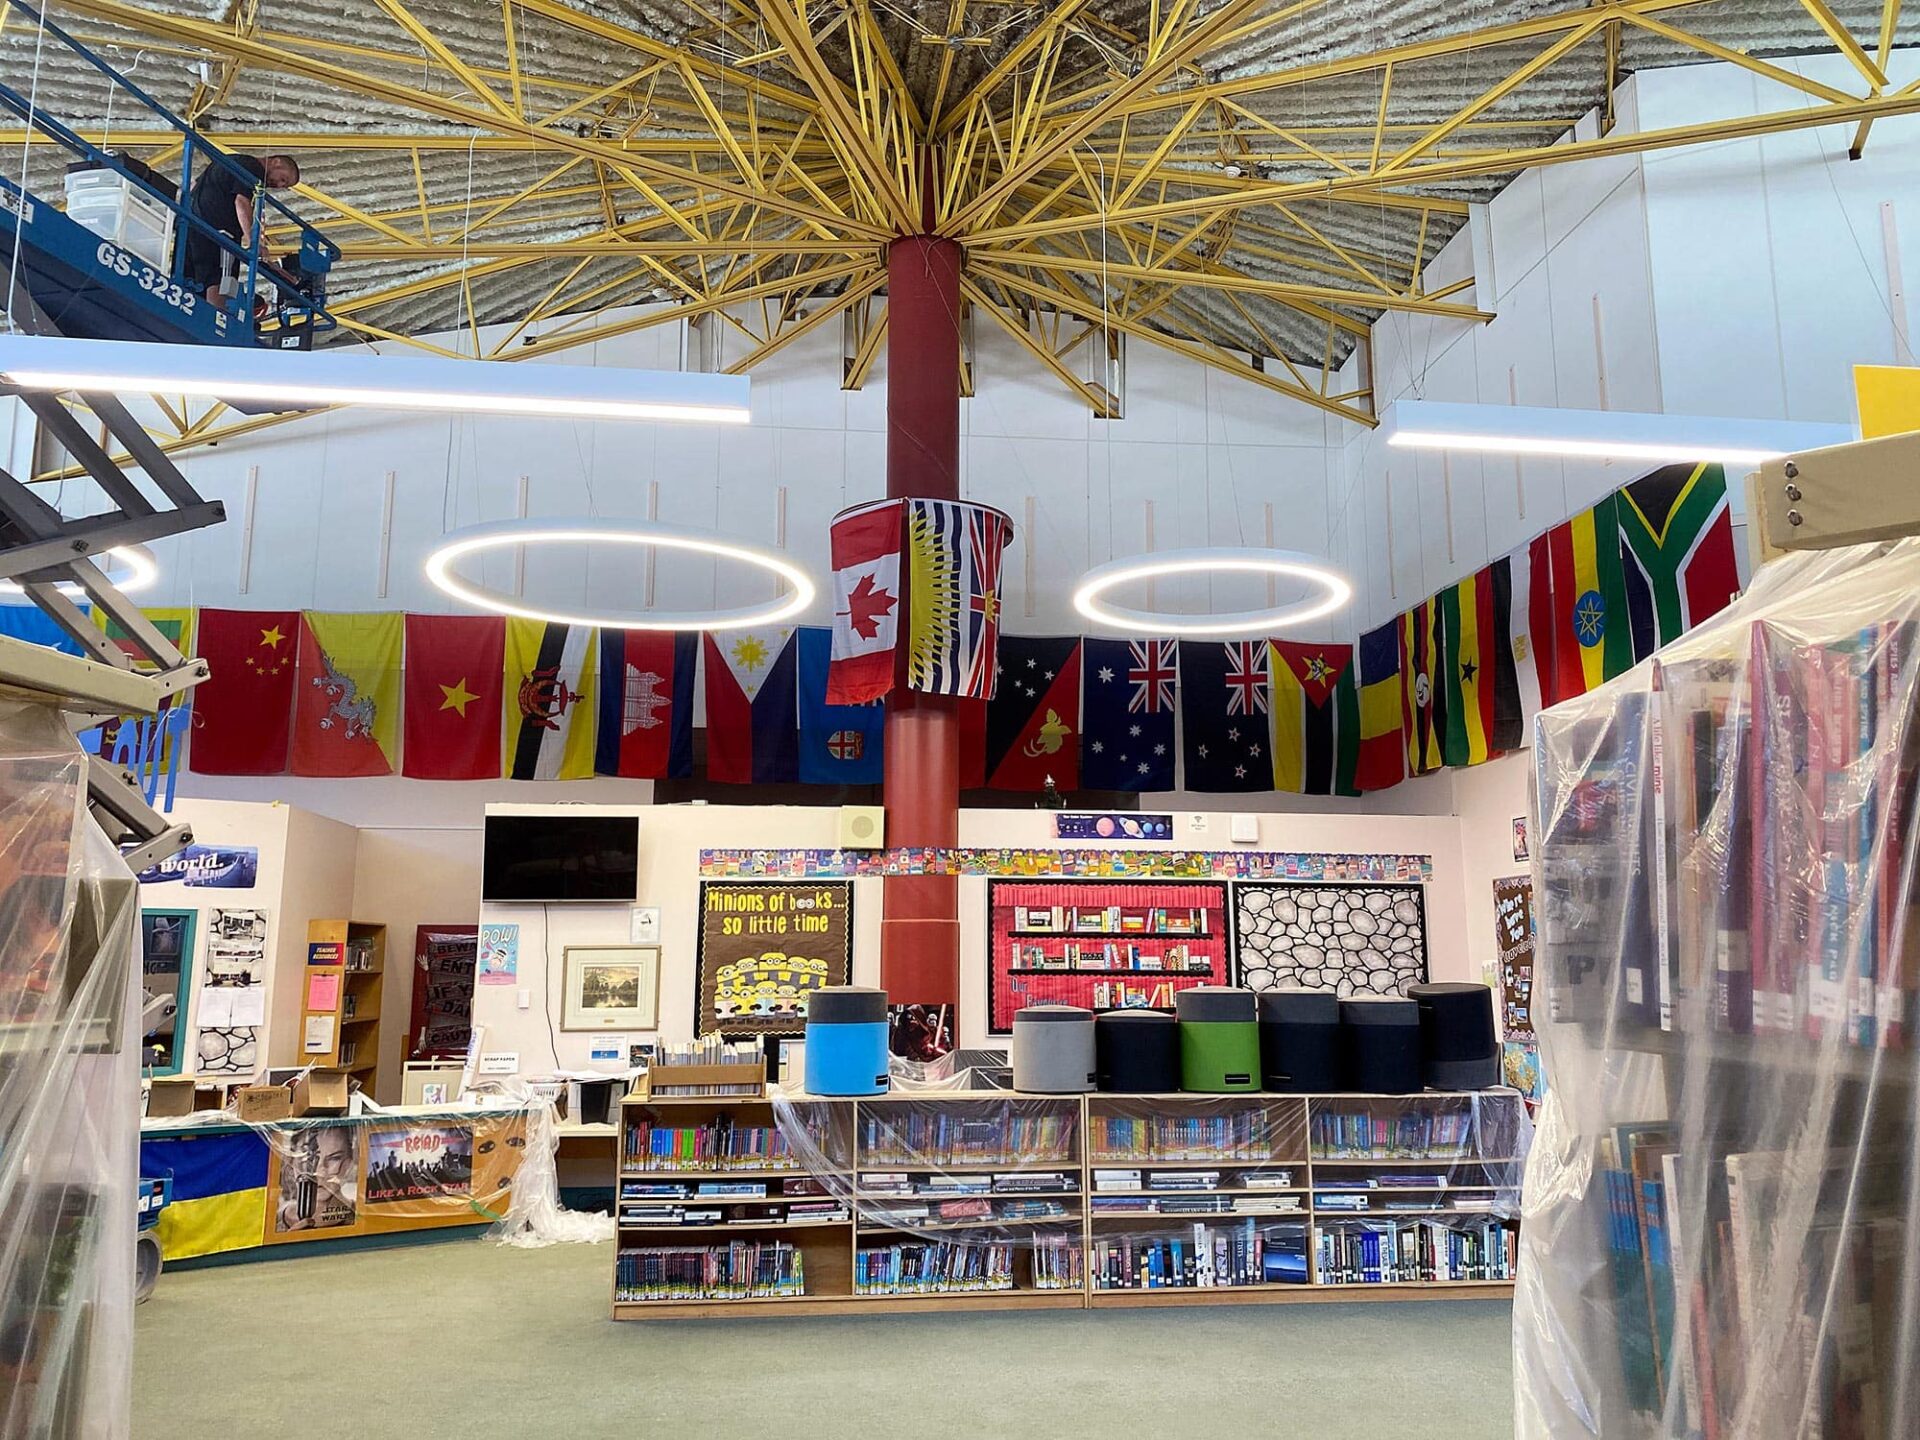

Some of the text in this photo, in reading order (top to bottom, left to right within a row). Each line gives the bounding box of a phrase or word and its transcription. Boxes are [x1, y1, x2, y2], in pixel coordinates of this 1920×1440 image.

[96, 242, 196, 316] GS-3232
[1655, 743, 1663, 763] like
[1624, 761, 1637, 807] CIVIL
[1654, 765, 1663, 794] mine
[159, 853, 225, 874] world.
[708, 892, 765, 912] Minions
[769, 892, 785, 912] of
[749, 916, 787, 934] little
[793, 914, 829, 933] time
[482, 926, 518, 947] POW!
[405, 1135, 441, 1153] READ
[368, 1189, 394, 1199] LIKE
[396, 1188, 404, 1197] A
[408, 1185, 438, 1195] ROCK
